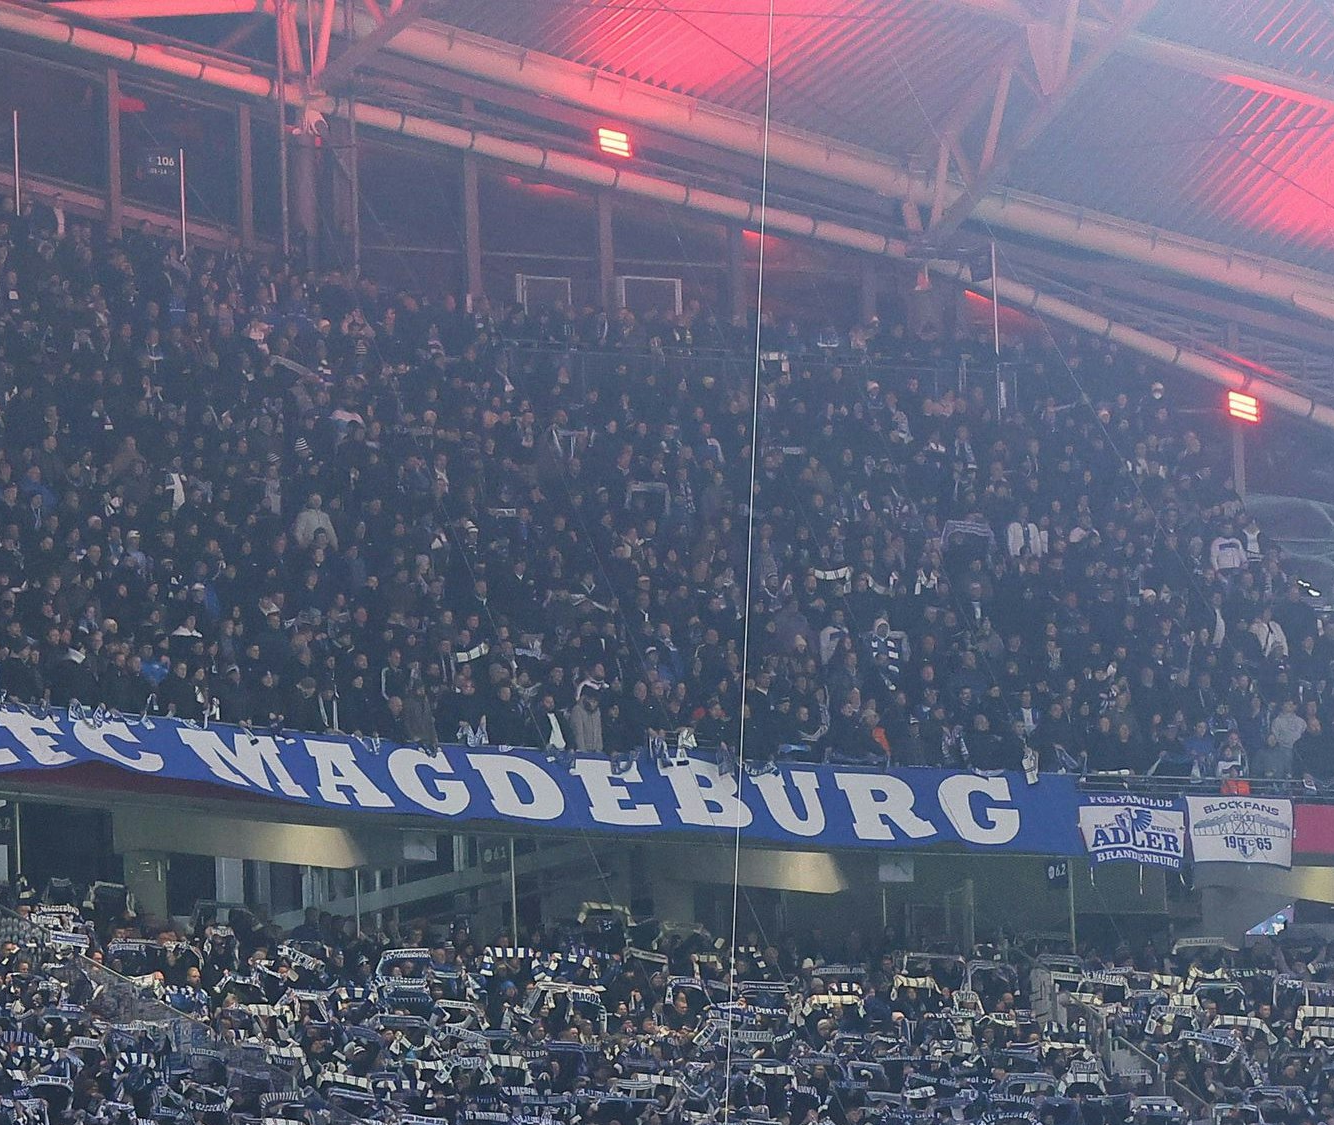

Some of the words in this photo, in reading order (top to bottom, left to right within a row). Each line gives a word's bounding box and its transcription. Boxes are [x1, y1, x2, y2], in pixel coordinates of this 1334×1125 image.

[176, 728, 1020, 845] MAGDEBURG
[1203, 801, 1279, 816] BLOCKFANS
[1091, 827, 1181, 853] ADLER
[1256, 837, 1272, 851] 65
[1096, 850, 1180, 868] BRANDENBURG
[1055, 864, 1067, 877] 6.2
